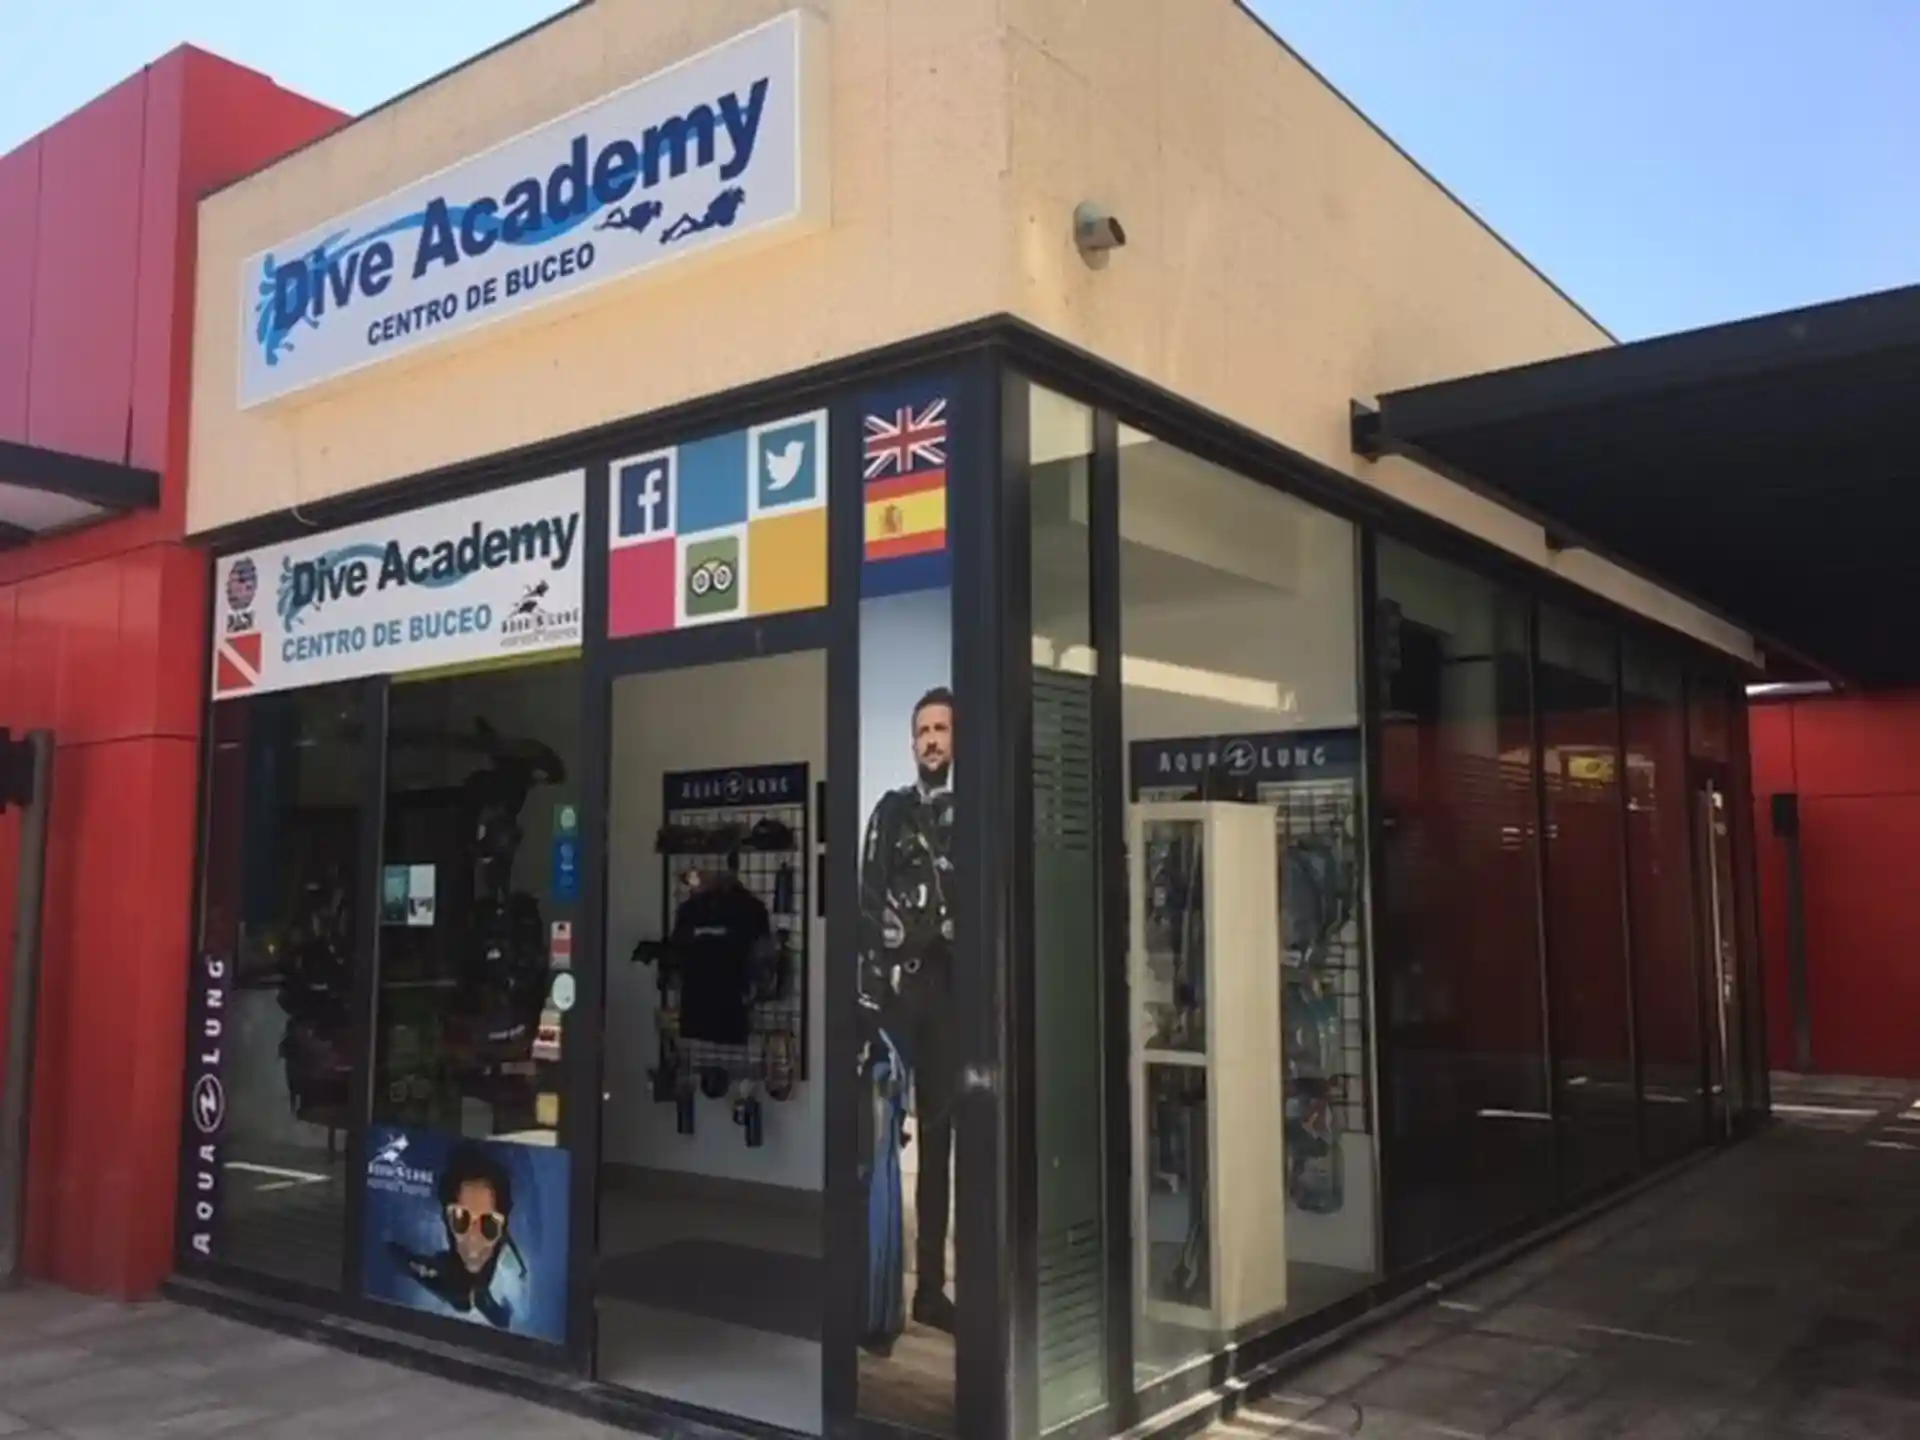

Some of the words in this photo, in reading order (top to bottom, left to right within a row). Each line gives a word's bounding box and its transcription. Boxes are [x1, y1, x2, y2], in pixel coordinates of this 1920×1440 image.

[275, 241, 393, 331] Dive
[412, 77, 769, 279] Academy
[367, 291, 457, 345] CENTRO
[466, 278, 497, 312] DE
[506, 242, 595, 297] BUCEO
[291, 556, 368, 608] Dive
[377, 512, 579, 590] Academy
[282, 619, 366, 663] CENTRO
[373, 614, 401, 648] DE
[409, 603, 493, 642] BUCEO
[1262, 746, 1326, 768] LUNG
[202, 958, 225, 1064] LUNG
[193, 1144, 216, 1254] AQUA
